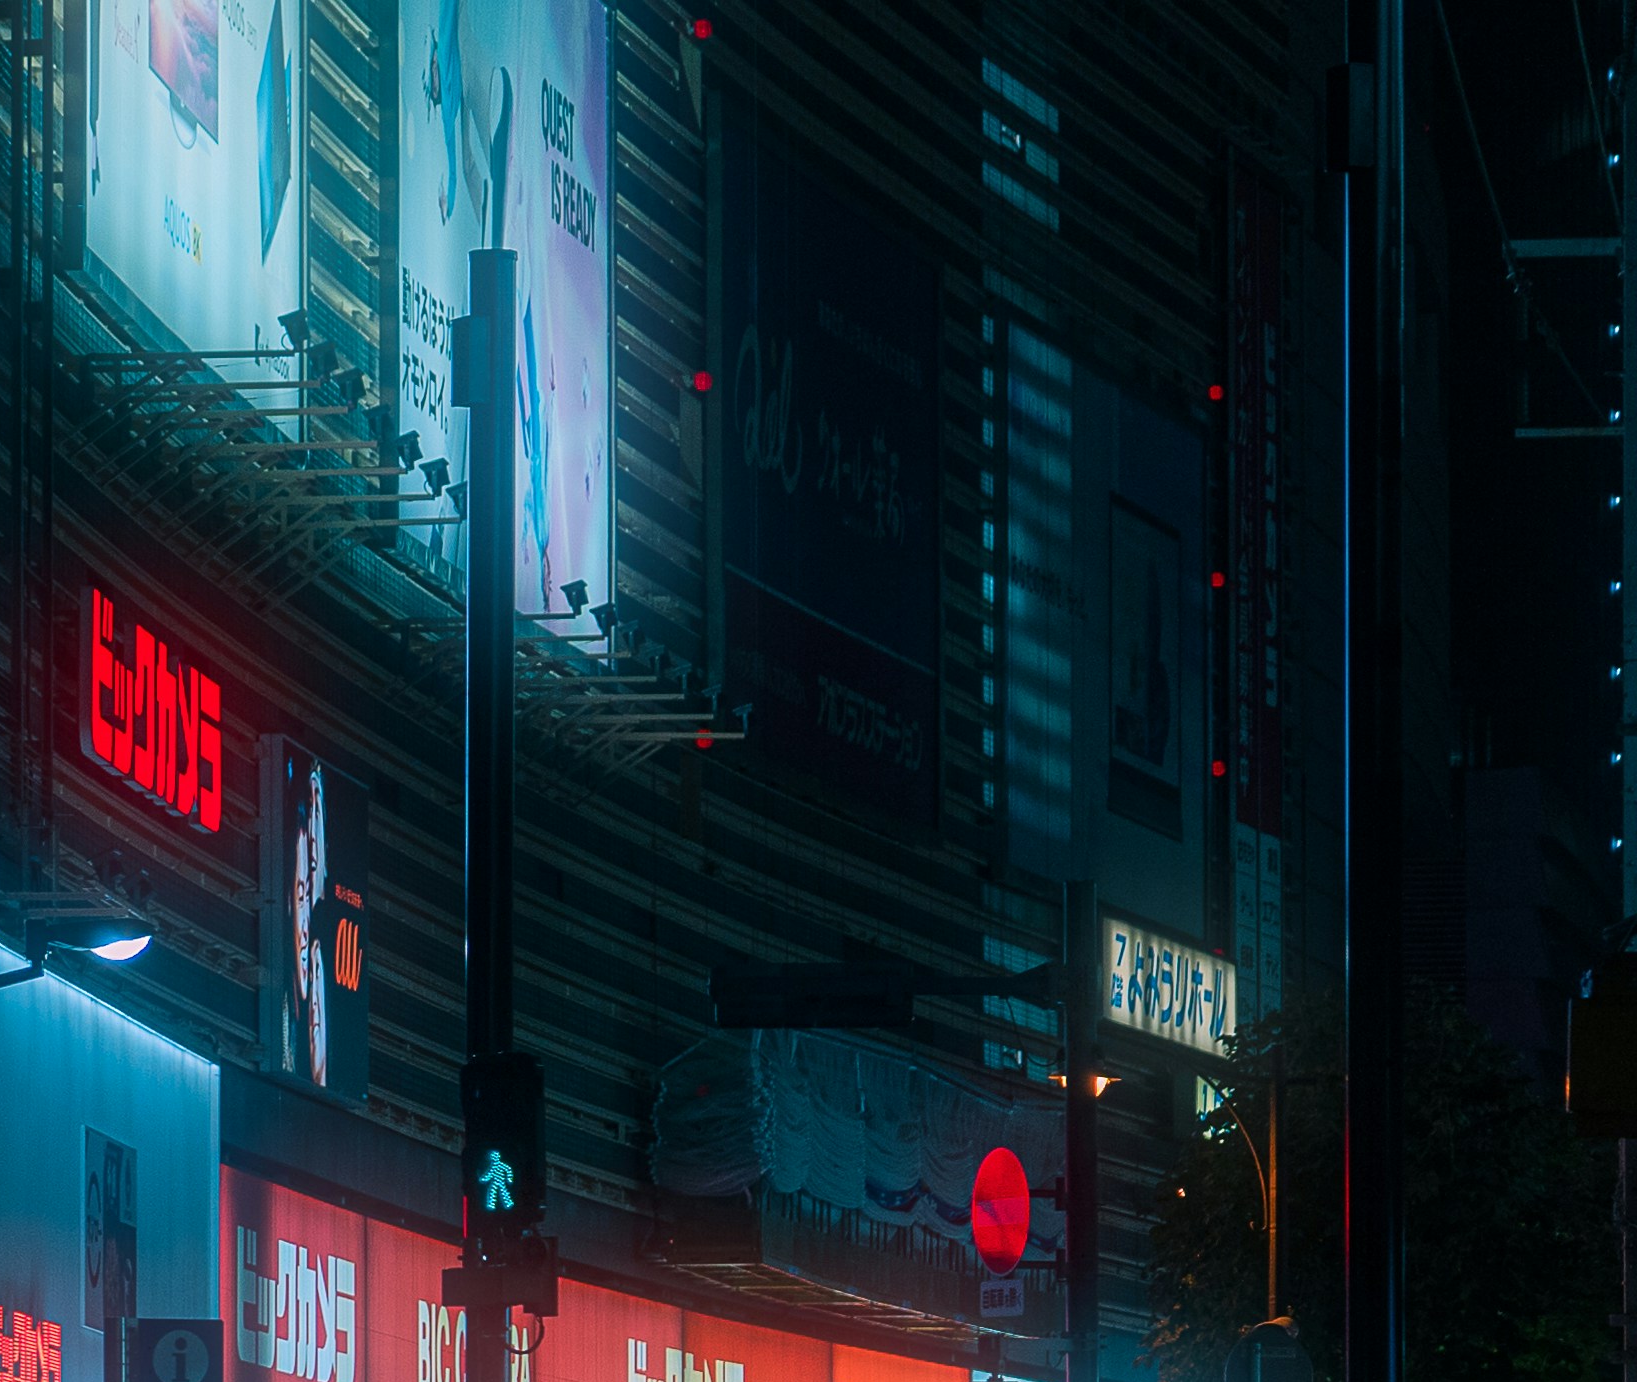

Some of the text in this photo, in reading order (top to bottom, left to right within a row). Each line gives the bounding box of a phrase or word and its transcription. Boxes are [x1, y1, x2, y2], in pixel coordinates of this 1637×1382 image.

[541, 78, 575, 162] QUEST
[164, 194, 191, 254] AQUOS
[551, 159, 597, 253] IS READY
[402, 345, 448, 435] オモシロイ。
[92, 588, 222, 833] ビックカメラ
